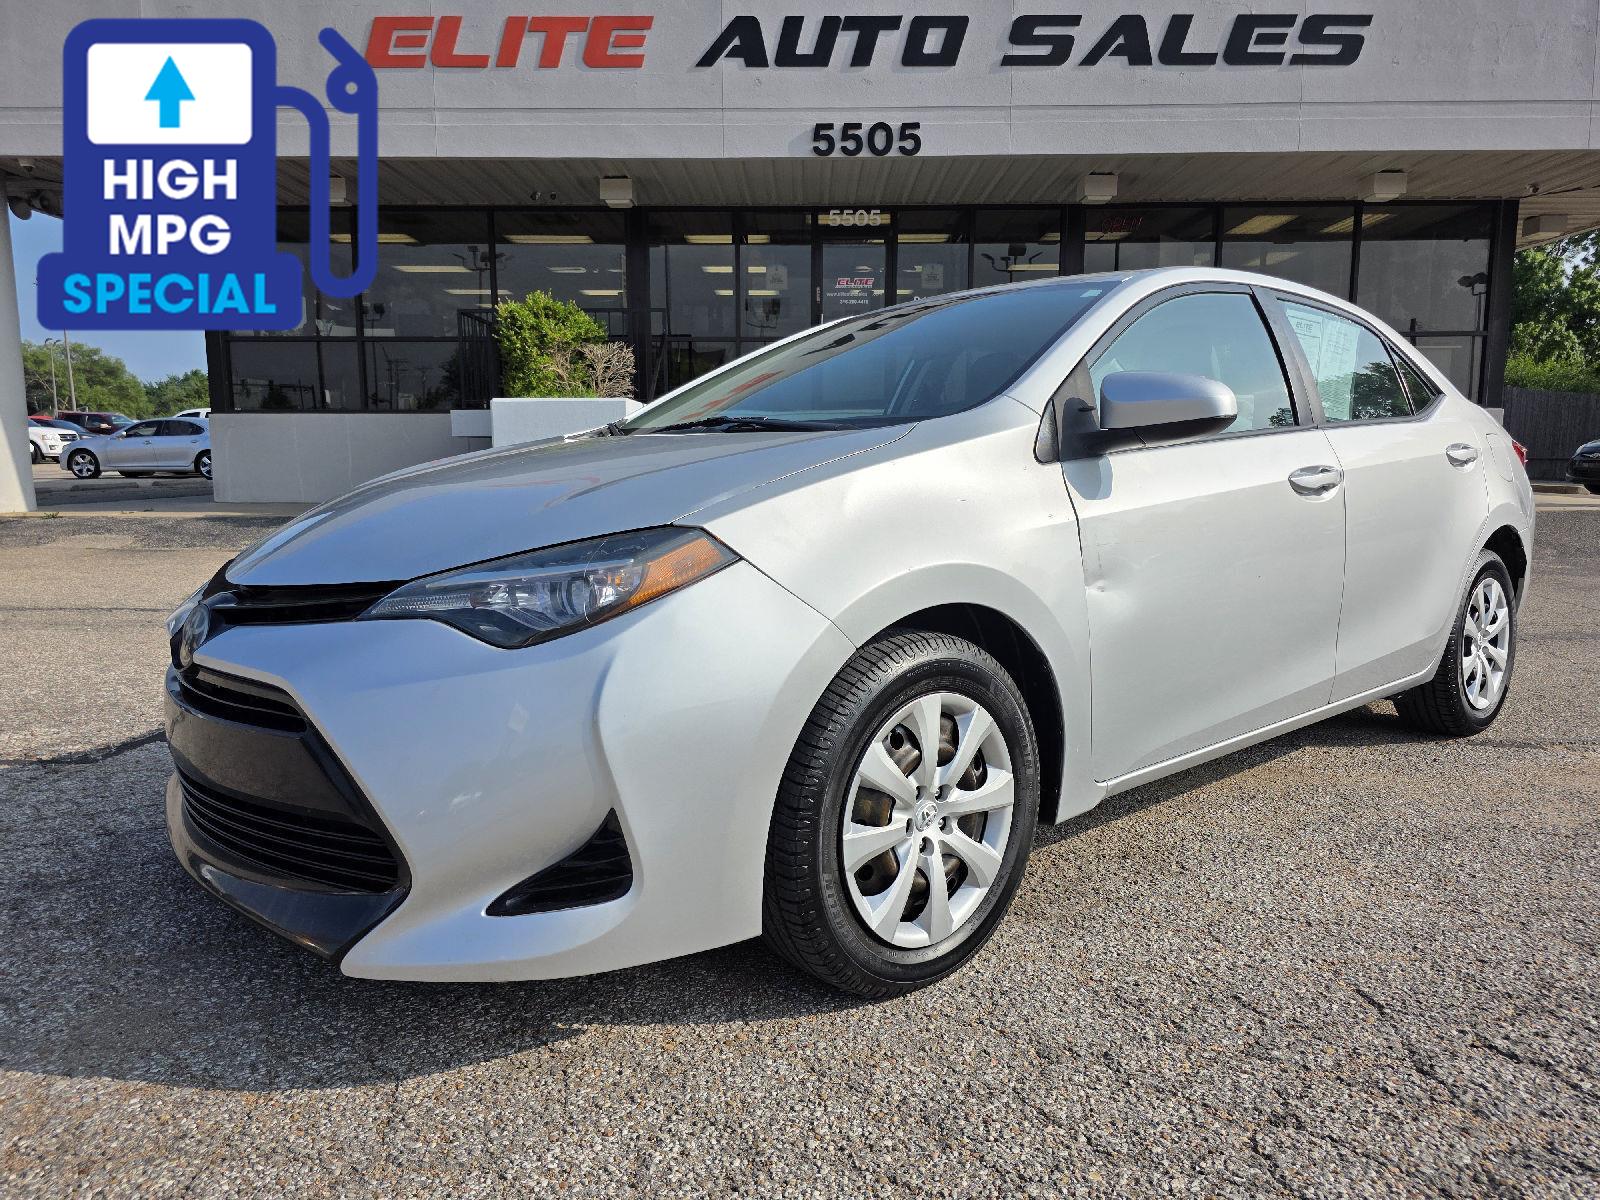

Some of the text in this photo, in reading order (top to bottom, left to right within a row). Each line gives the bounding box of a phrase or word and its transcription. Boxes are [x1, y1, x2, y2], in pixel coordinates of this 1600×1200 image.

[365, 13, 1374, 68] ELITE AUTO SALES
[812, 121, 922, 157] 5505
[828, 209, 882, 226] 5505
